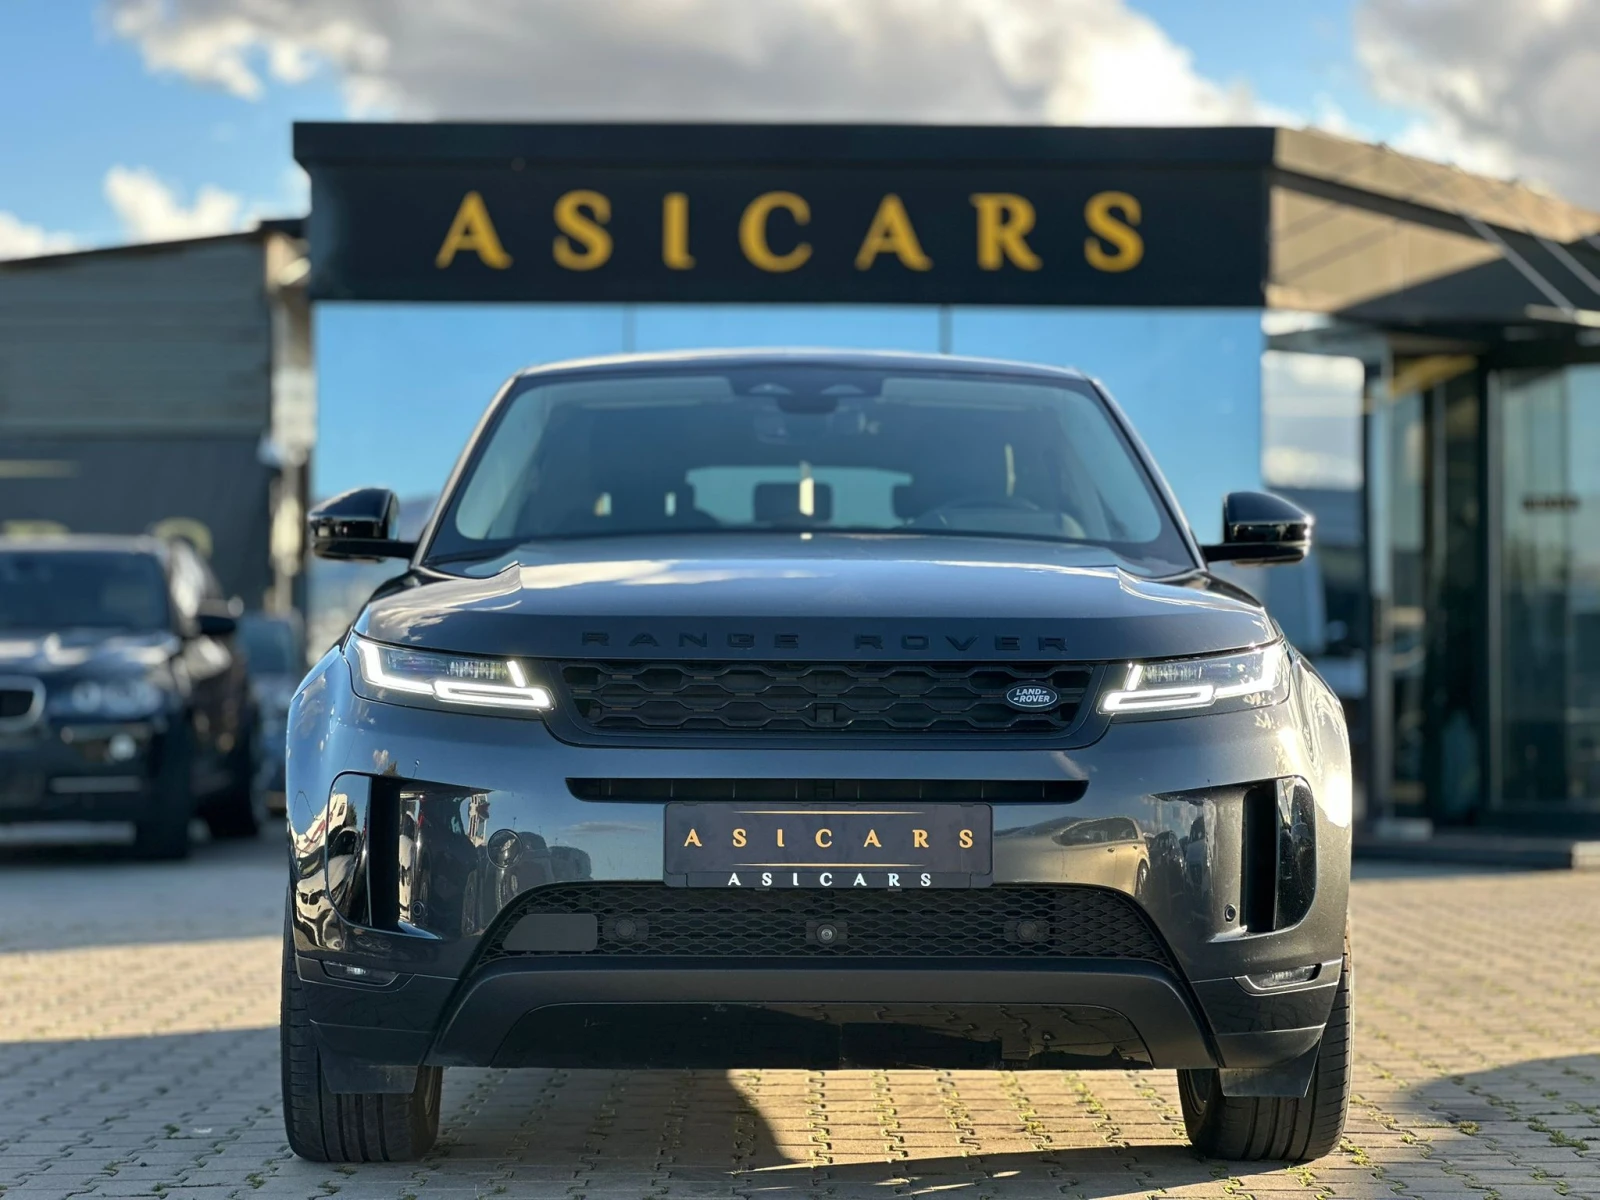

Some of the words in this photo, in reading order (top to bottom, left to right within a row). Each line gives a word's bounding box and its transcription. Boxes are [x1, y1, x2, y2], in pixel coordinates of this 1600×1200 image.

[434, 189, 1146, 273] ASICARS
[581, 632, 799, 649] RANGE
[854, 634, 1068, 651] ROVER
[683, 828, 974, 848] ASICARS
[727, 872, 931, 887] ASICARS
